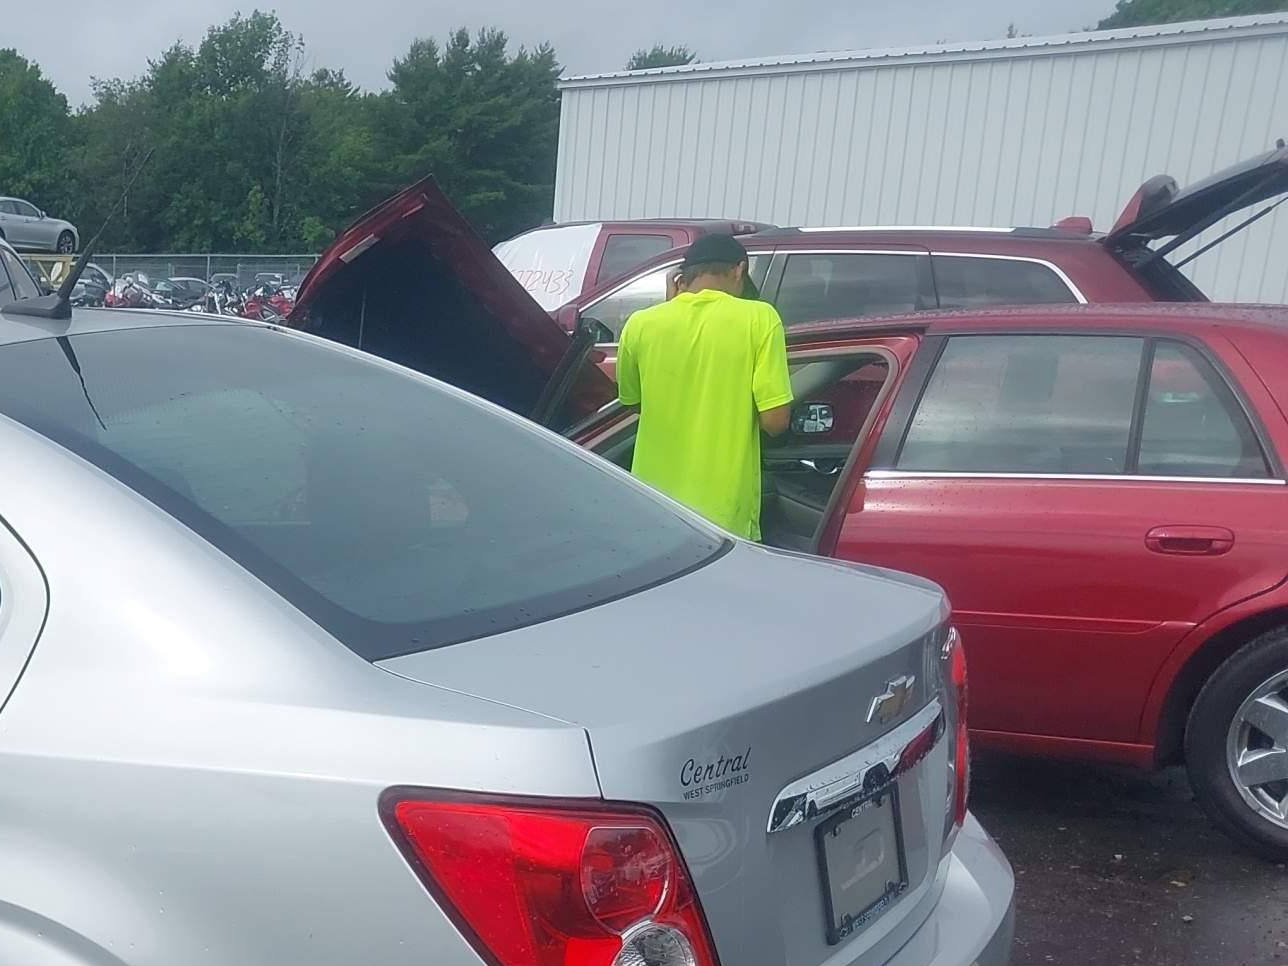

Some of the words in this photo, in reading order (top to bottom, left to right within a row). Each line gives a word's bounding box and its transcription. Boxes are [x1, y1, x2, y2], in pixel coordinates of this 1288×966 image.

[511, 269, 574, 295] 772433
[680, 747, 751, 787] Central
[683, 787, 704, 801] WEST
[705, 773, 749, 794] SPRINGFIELD
